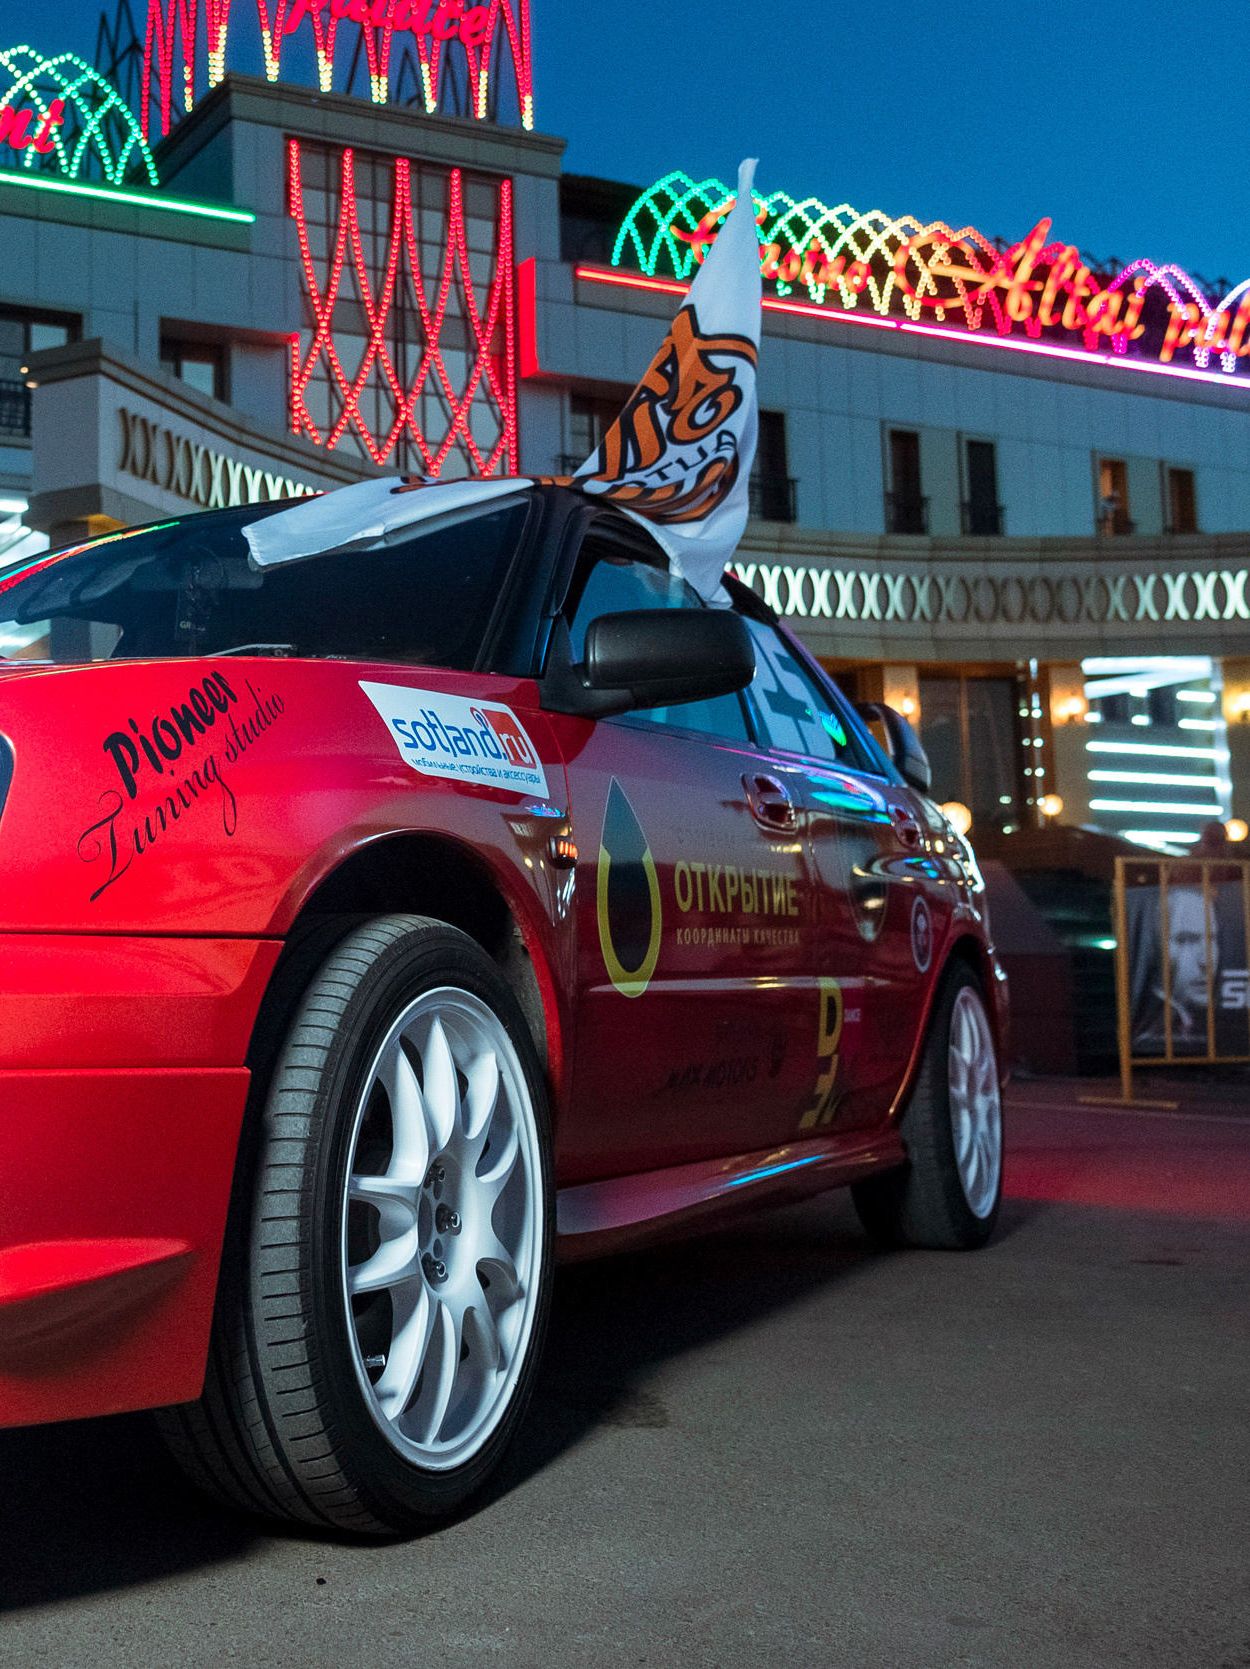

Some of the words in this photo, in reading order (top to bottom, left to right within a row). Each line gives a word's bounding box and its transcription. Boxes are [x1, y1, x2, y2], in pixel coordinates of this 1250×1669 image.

[894, 217, 1145, 341] Altai
[1159, 288, 1250, 362] pal
[103, 670, 238, 799] Pioneer
[391, 708, 534, 764] sotland.ru
[78, 755, 237, 902] Tuning
[225, 678, 285, 763] studio
[674, 860, 799, 916] ОТКРЫТИЕ
[676, 928, 750, 947] КООРДИНАТЫ
[754, 928, 800, 946] КАЧЕСТВА
